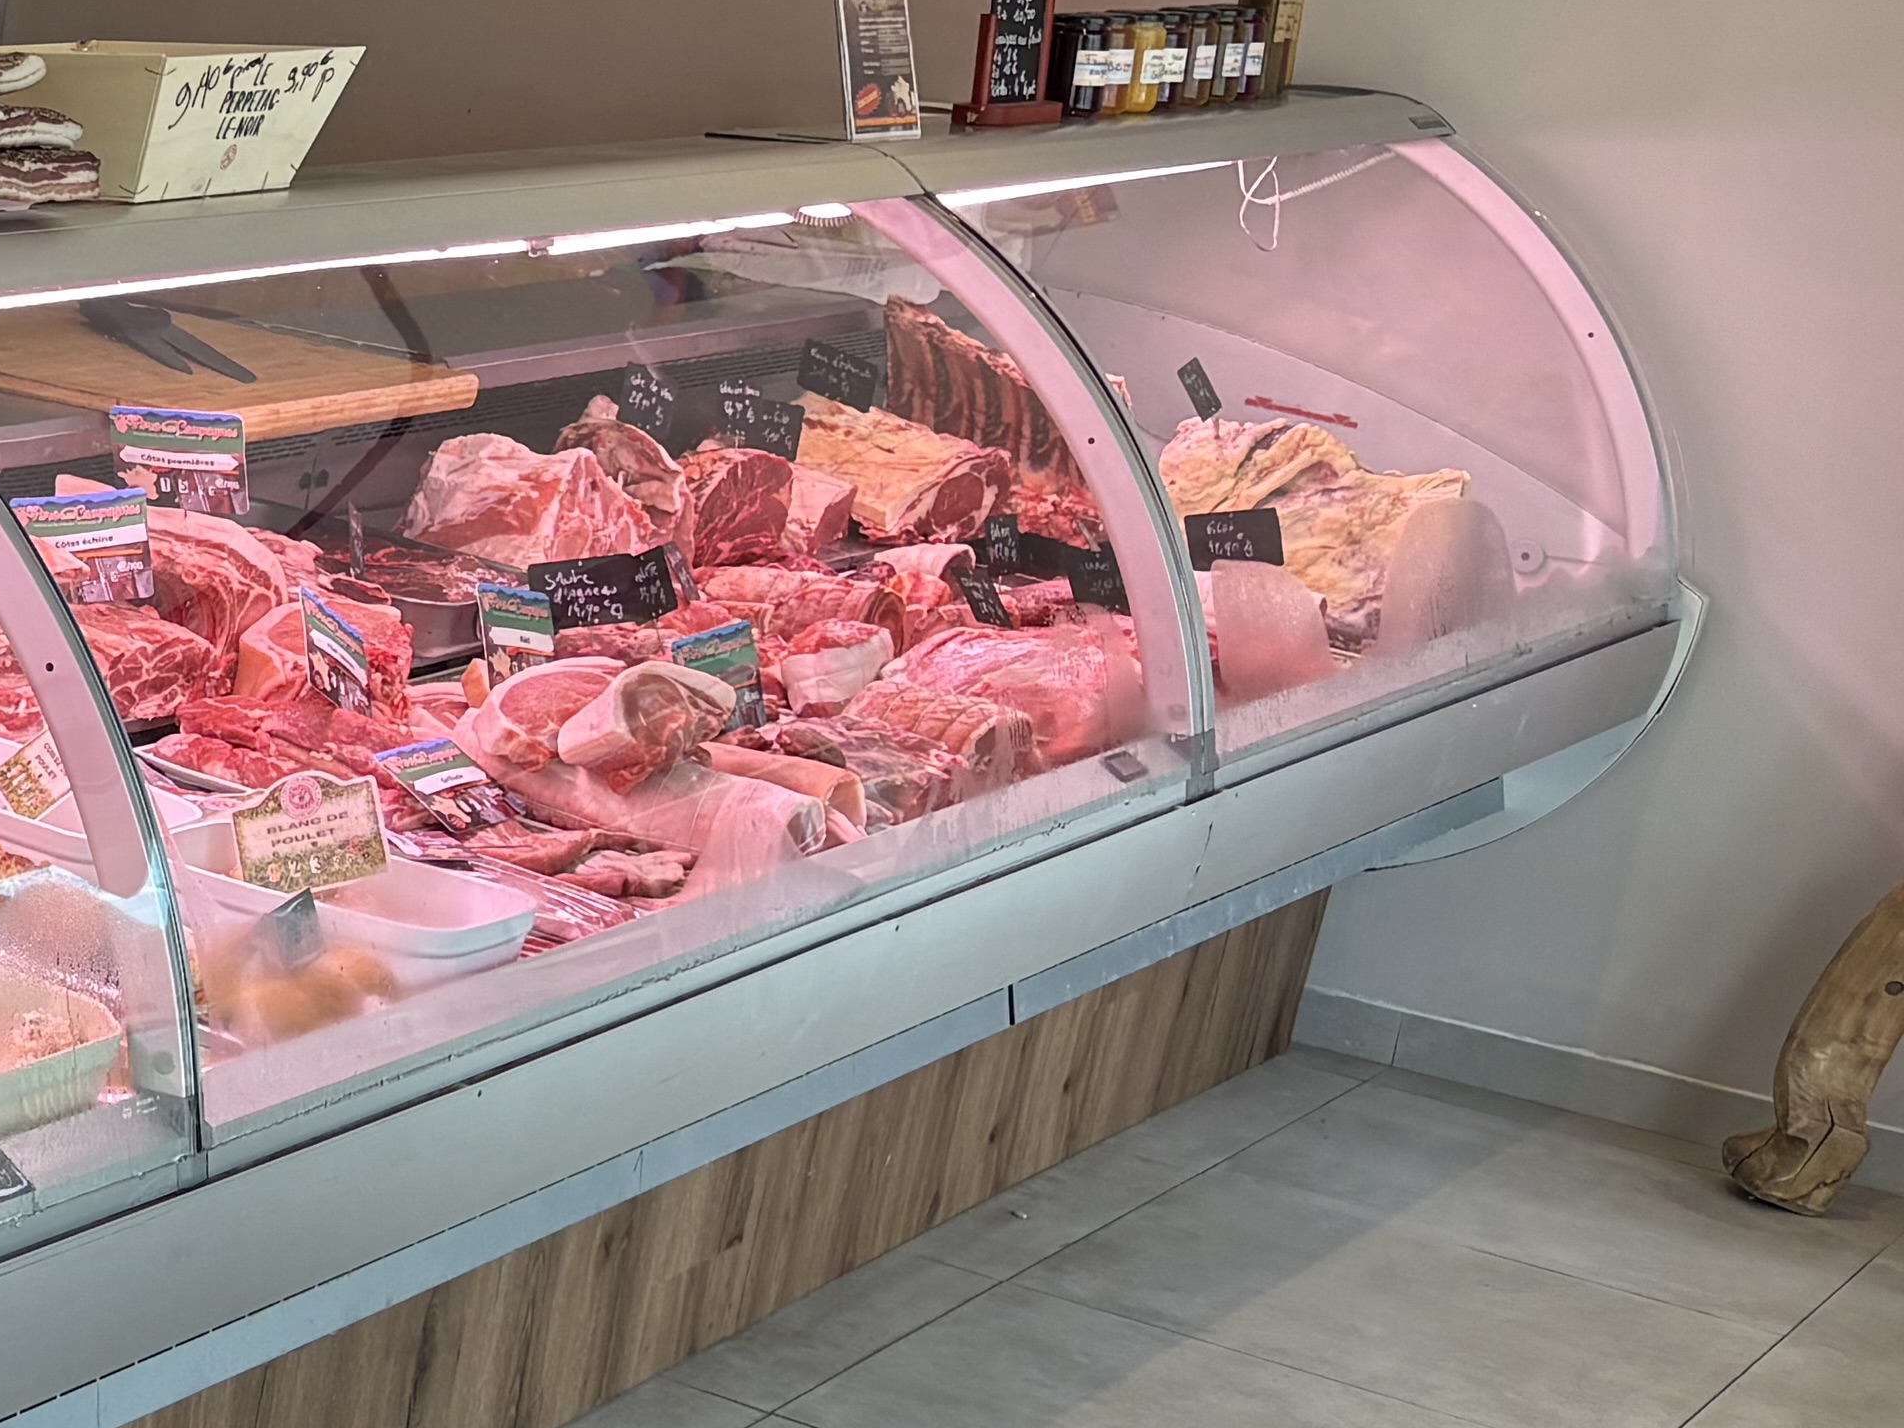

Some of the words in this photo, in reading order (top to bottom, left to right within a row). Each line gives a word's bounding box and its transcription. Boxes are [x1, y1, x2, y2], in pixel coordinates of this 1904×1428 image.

[266, 816, 311, 835] BLANC
[326, 812, 348, 824] DE
[271, 828, 336, 848] POULET
